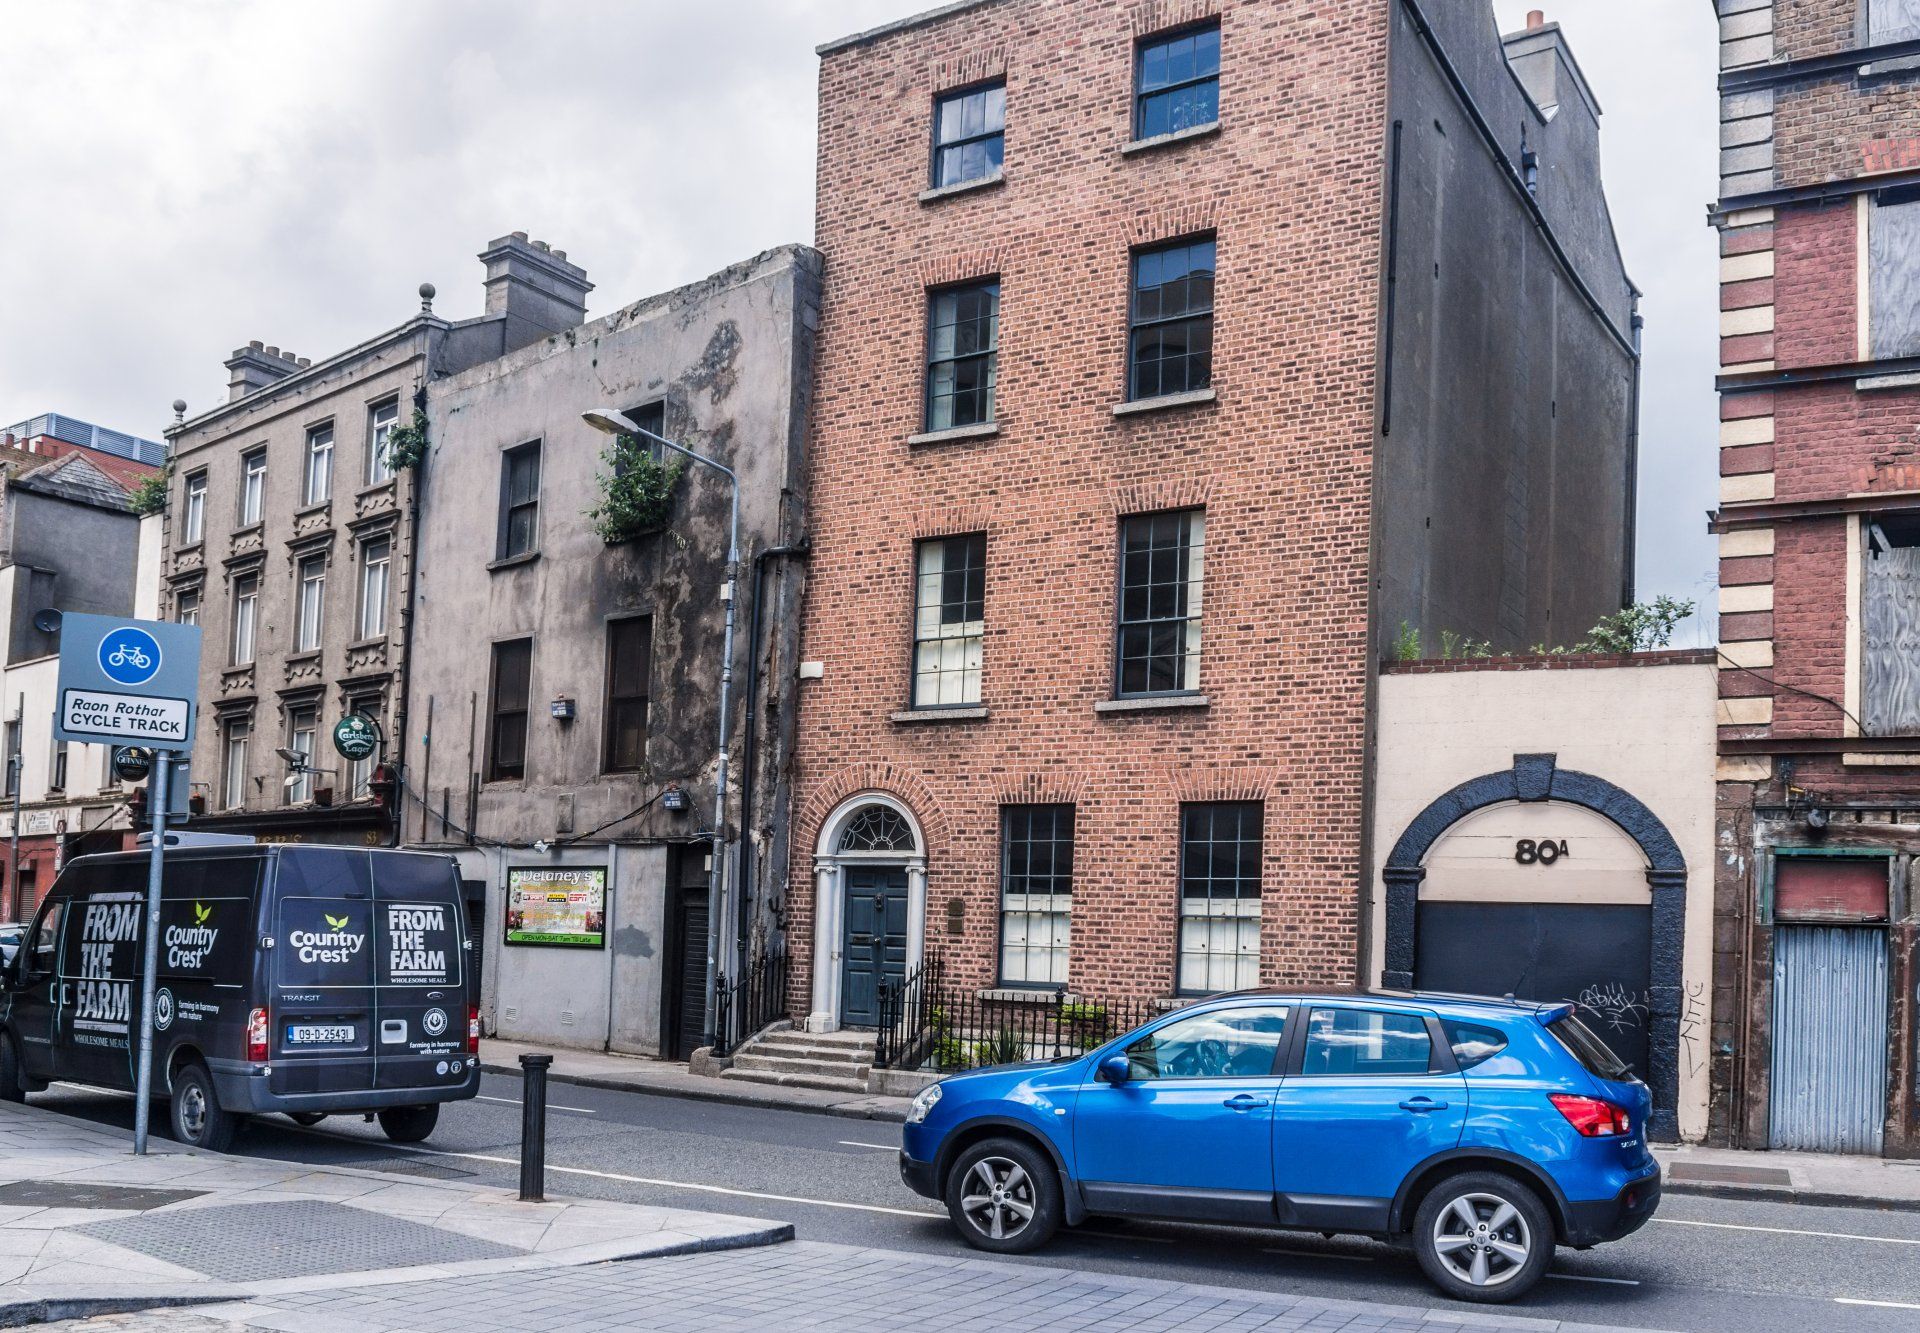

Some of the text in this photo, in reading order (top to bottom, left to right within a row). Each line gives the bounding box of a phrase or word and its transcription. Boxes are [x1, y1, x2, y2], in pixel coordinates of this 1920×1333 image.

[72, 698, 166, 717] Raon Rothar
[71, 713, 180, 733] CYCLE TRACK
[338, 728, 374, 742] Carlsberg
[346, 746, 370, 756] Lager
[366, 831, 377, 845] 83
[1515, 838, 1569, 865] 80A
[523, 870, 592, 885] Delaney's
[82, 904, 141, 942] FROM
[388, 910, 445, 931] FROM
[165, 925, 218, 955] Country
[290, 930, 365, 954] Country
[389, 931, 425, 950] THE
[81, 943, 114, 980] THE
[168, 945, 203, 969] Crest
[299, 946, 350, 963] Crest
[390, 950, 446, 970] FARM
[75, 980, 130, 1021] FARM
[281, 994, 321, 1002] TRANSIT
